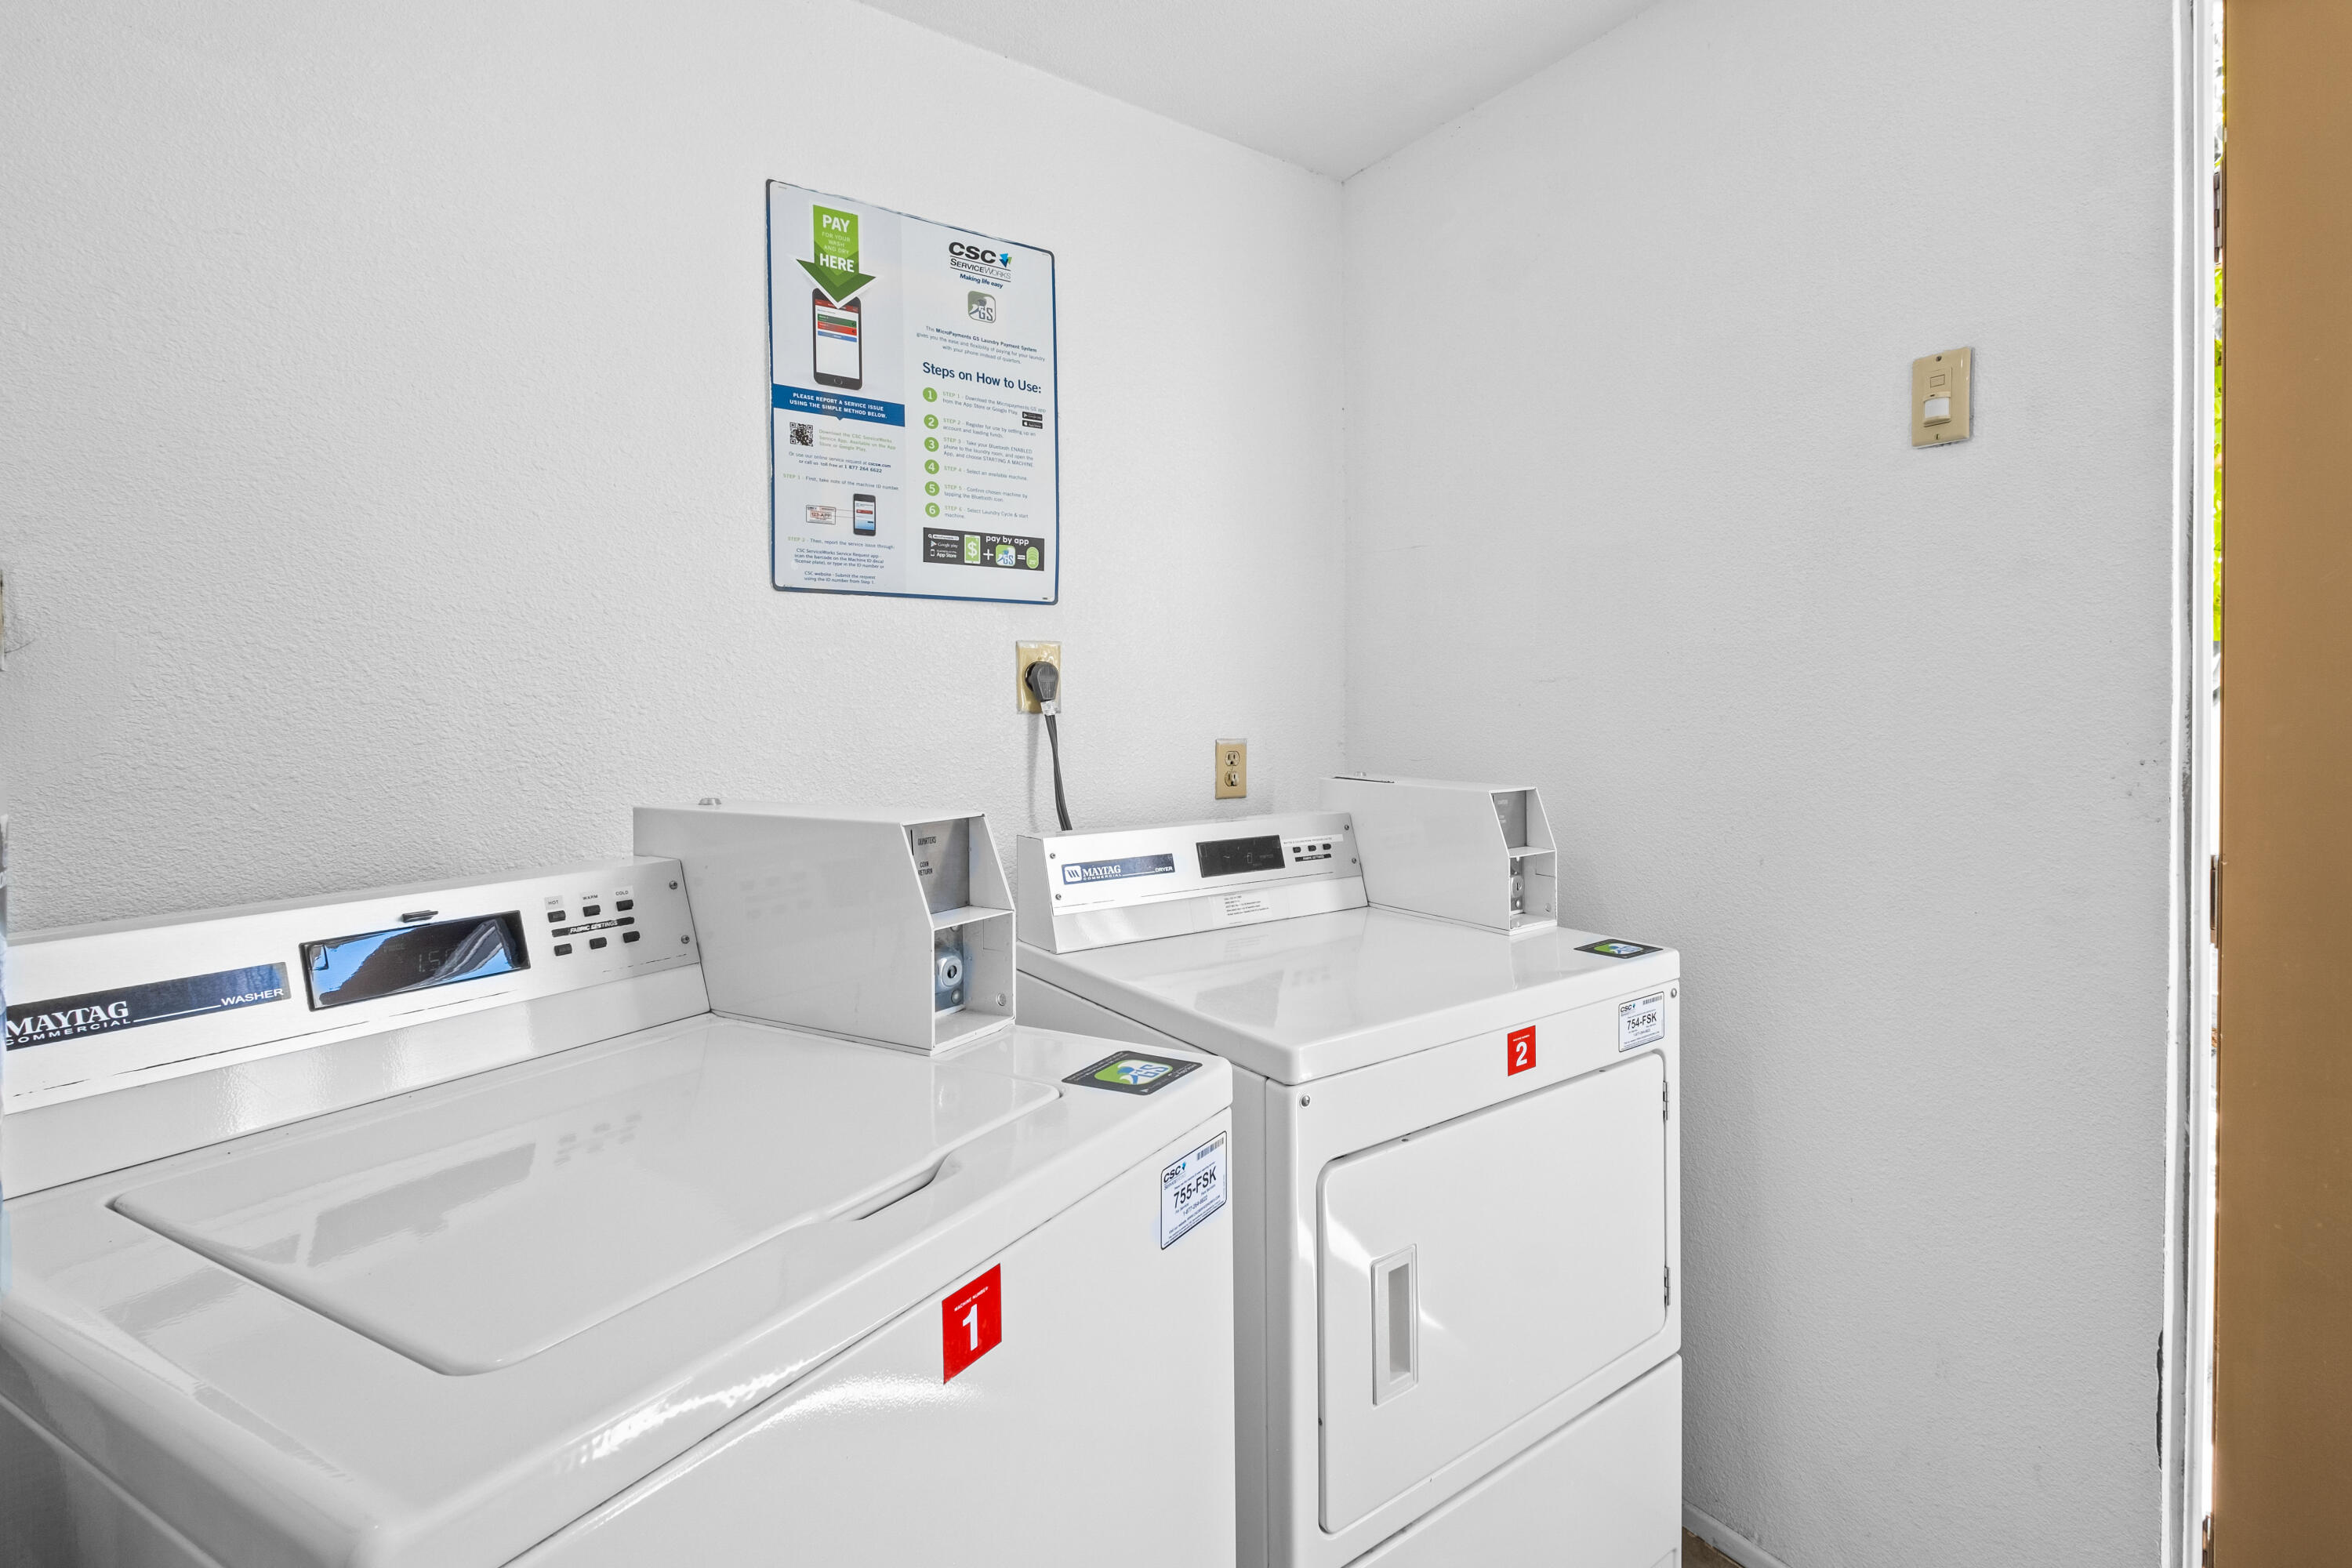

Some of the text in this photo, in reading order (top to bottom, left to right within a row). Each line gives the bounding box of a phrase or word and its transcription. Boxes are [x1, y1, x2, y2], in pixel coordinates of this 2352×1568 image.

[822, 215, 850, 232] PAY
[829, 239, 844, 248] WASH
[949, 241, 996, 263] CSC
[820, 253, 855, 273] HERE
[960, 274, 980, 284] Making
[936, 328, 971, 339] MicroPayments
[981, 337, 999, 346] Laundry
[1000, 341, 1020, 350] Payment
[922, 362, 1042, 394] Steps on How to Use:
[927, 390, 933, 400] 1
[928, 417, 935, 426] 2
[928, 440, 935, 448] 3
[928, 463, 935, 471] 4
[929, 484, 935, 493] 5
[929, 505, 935, 514] 6
[1004, 554, 1013, 564] GS
[918, 837, 937, 845] QUARTERS
[1082, 866, 1121, 877] MAYTAG
[221, 988, 284, 1006] WASHER
[7, 1000, 129, 1037] MAYTAG
[1627, 1012, 1657, 1030] 754-FSK
[6, 1020, 131, 1046] COMMERCIAL
[1516, 1041, 1527, 1066] 2
[1163, 1165, 1181, 1183] CSC
[1174, 1166, 1216, 1208] 755-FSK
[954, 1287, 989, 1312] MACHINE NUMBER
[962, 1303, 978, 1352] 1
